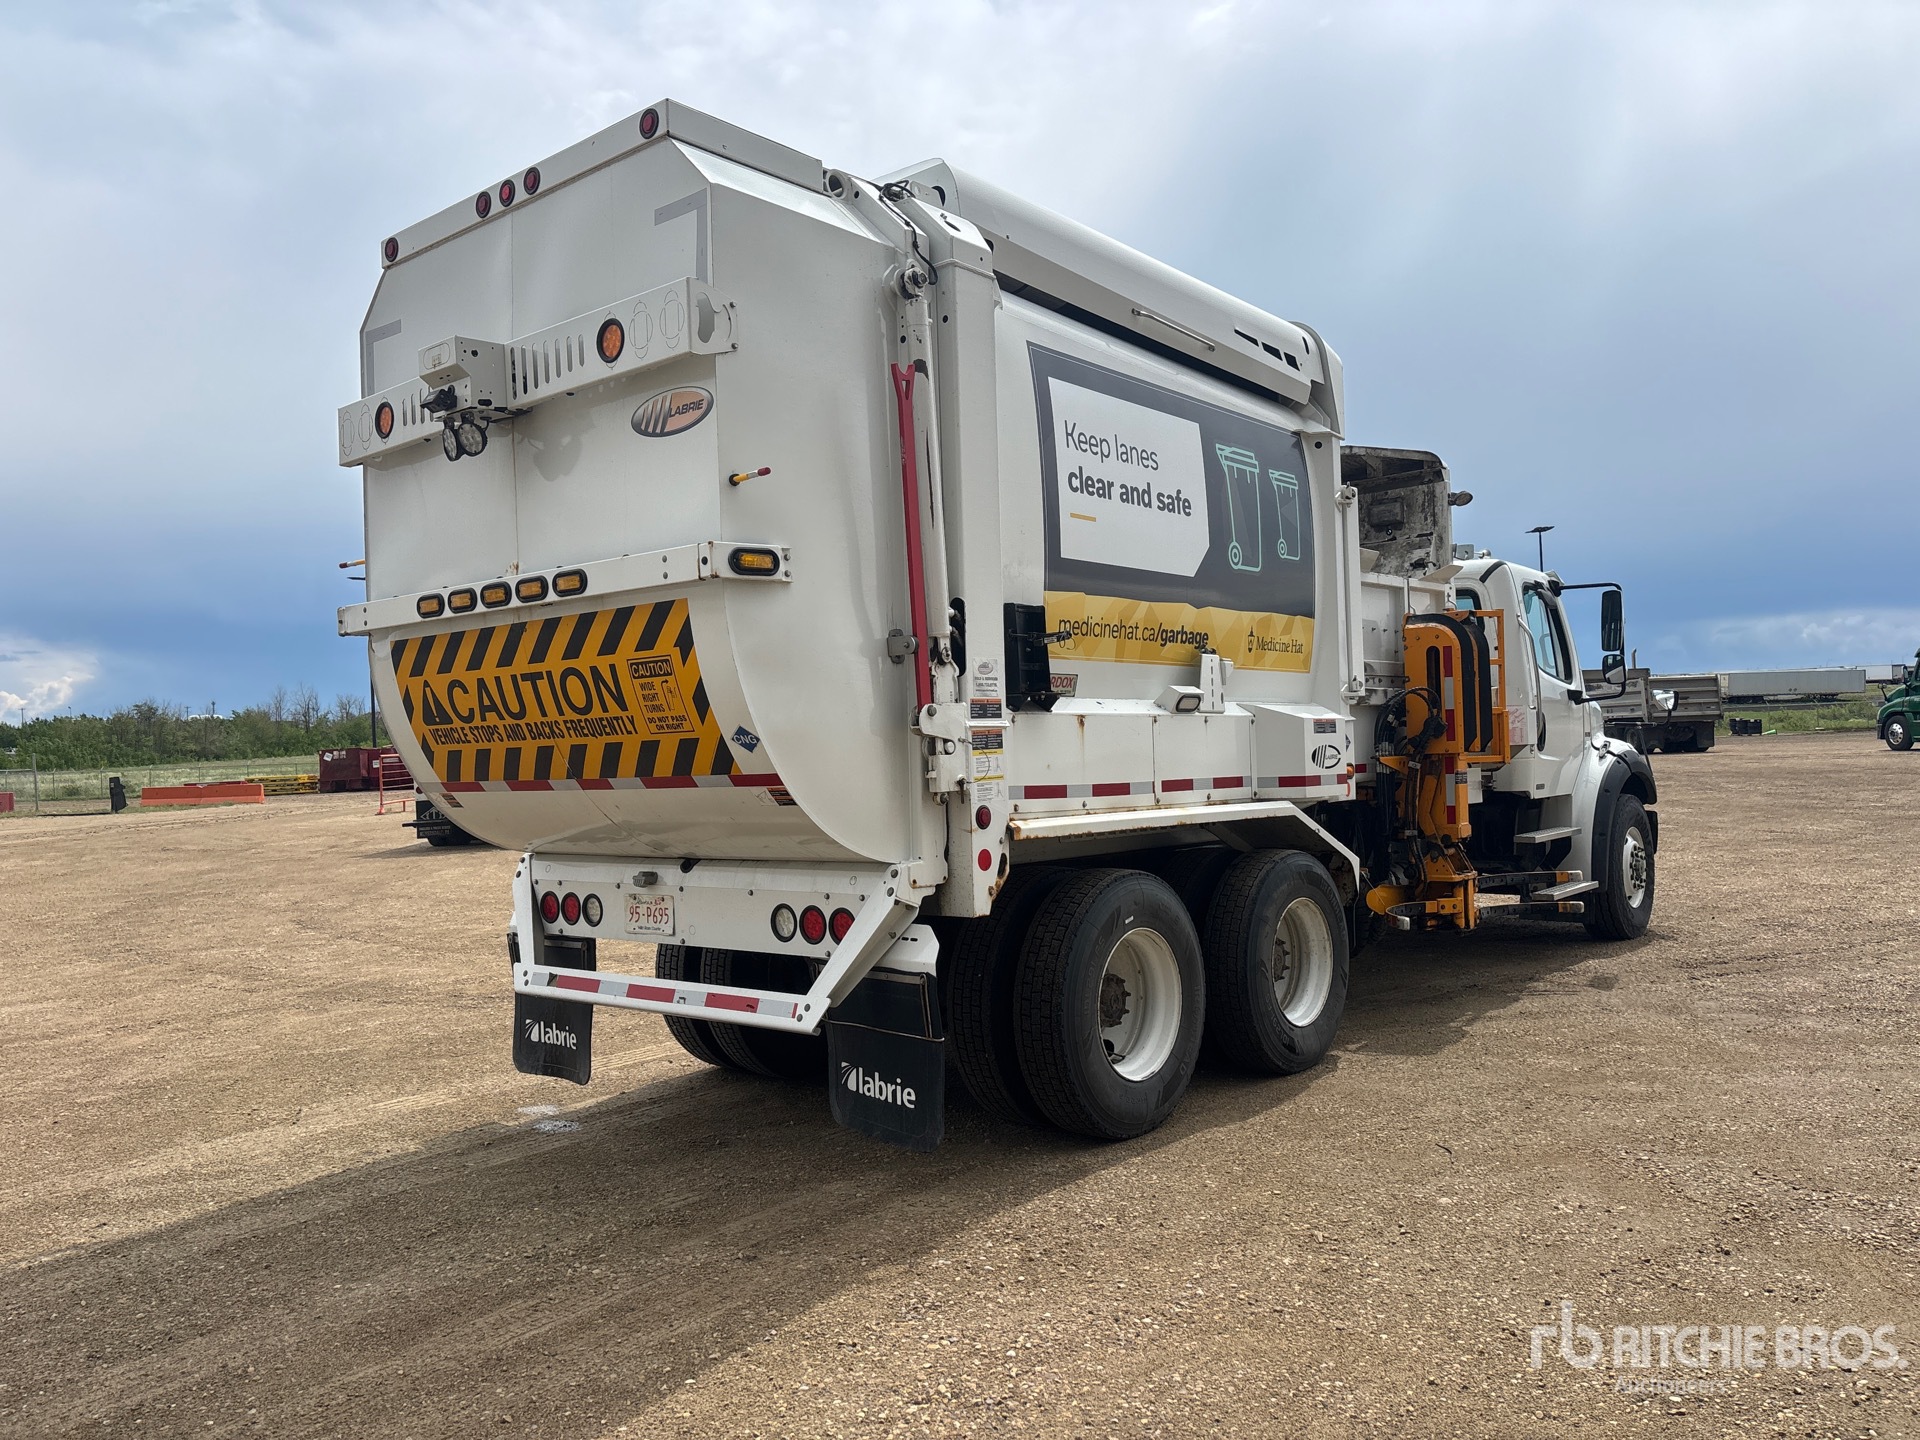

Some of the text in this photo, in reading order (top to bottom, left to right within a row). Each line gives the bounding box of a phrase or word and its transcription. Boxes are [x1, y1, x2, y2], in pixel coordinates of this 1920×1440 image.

[667, 398, 705, 418] LABRIE
[1064, 419, 1159, 471] Keep lanes
[1067, 465, 1192, 517] clear and safe
[1058, 616, 1209, 650] medicinehat.ca/garbage
[1255, 635, 1304, 654] Medicine Hat
[631, 661, 671, 677] CAUTION
[447, 663, 629, 725] CAUTION
[639, 681, 656, 691] WIDE
[641, 692, 660, 702] RIGHT
[644, 703, 666, 713] TURNS
[647, 716, 657, 724] DO
[670, 714, 687, 722] PASS
[665, 723, 685, 731] RIGHT
[428, 715, 639, 746] VEHICLE STOPS AND BACKS FREQUENTLY
[733, 734, 758, 744] CNG
[628, 905, 670, 925] 95-P695
[540, 1020, 577, 1050] labrie
[858, 1066, 916, 1109] labrie
